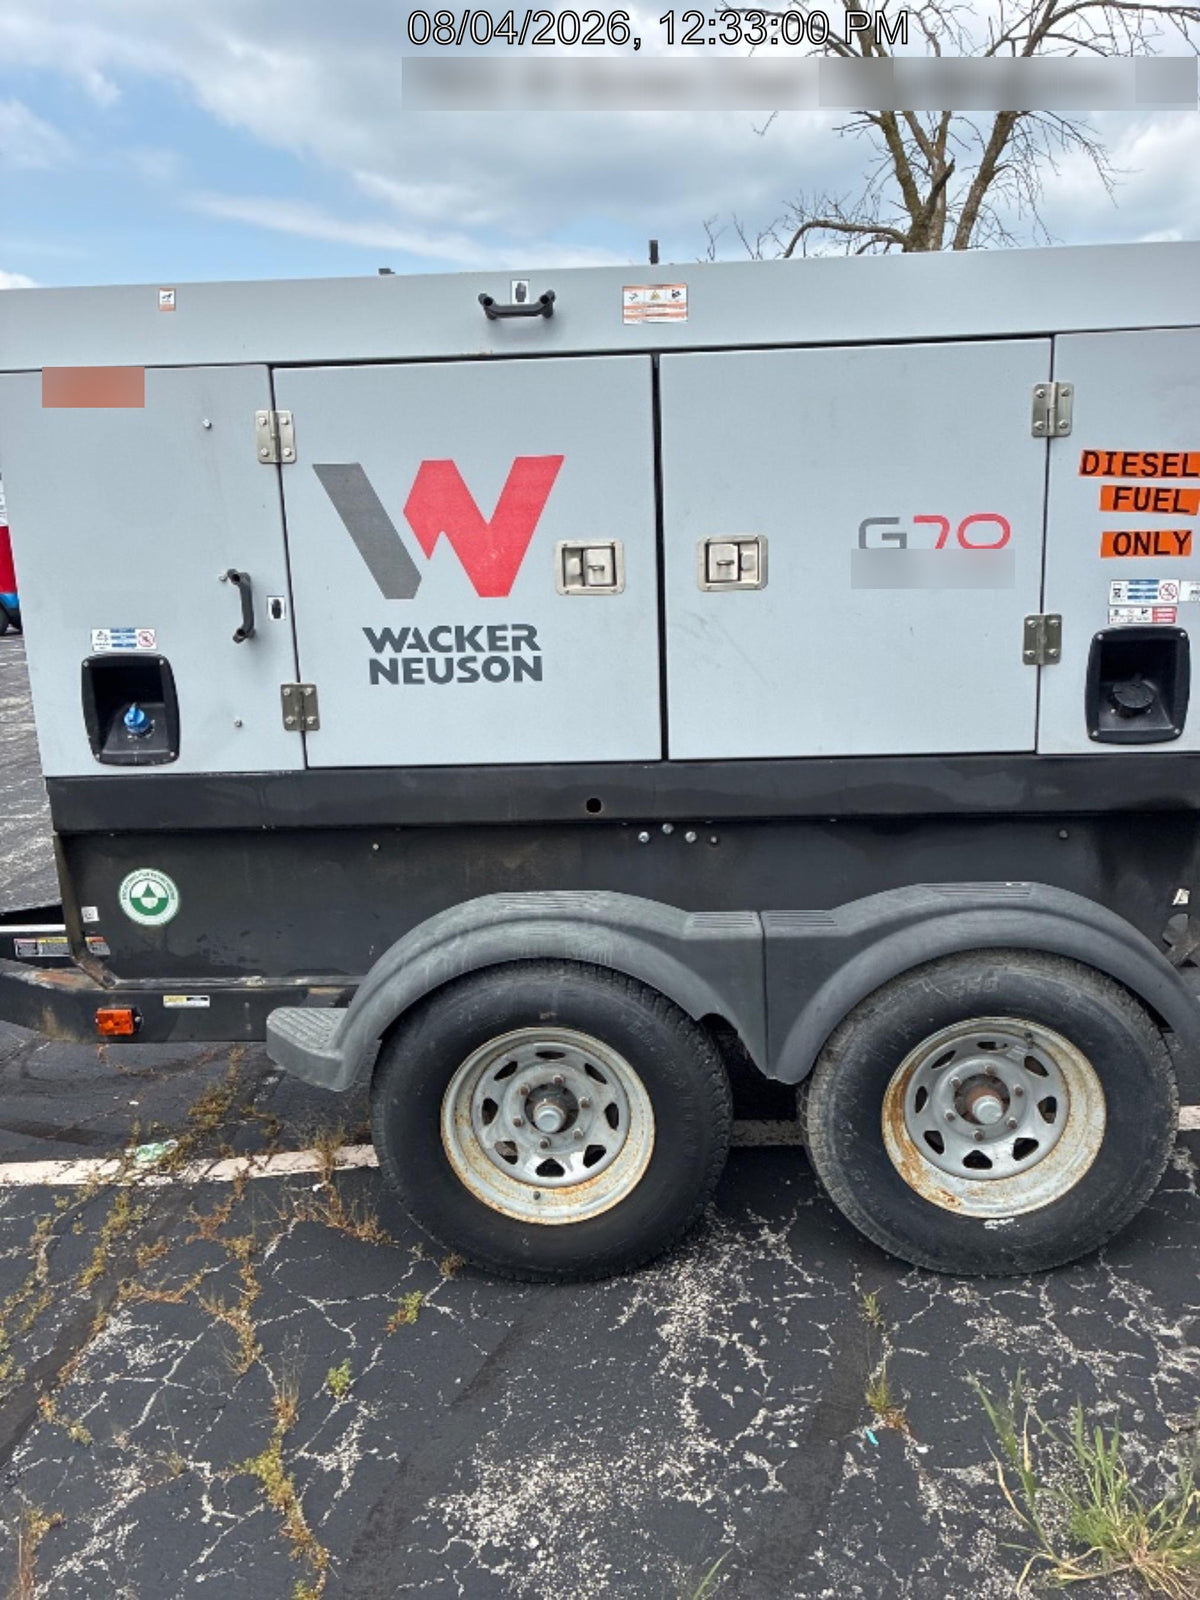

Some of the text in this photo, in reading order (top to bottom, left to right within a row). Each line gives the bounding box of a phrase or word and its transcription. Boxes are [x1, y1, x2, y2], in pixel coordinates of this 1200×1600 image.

[1080, 450, 1200, 477] DIESEL
[1112, 487, 1190, 513] FUEL
[858, 513, 1011, 549] G70
[1112, 530, 1192, 556] ONLY
[362, 624, 542, 653] WACKER
[369, 656, 543, 685] NEUSON
